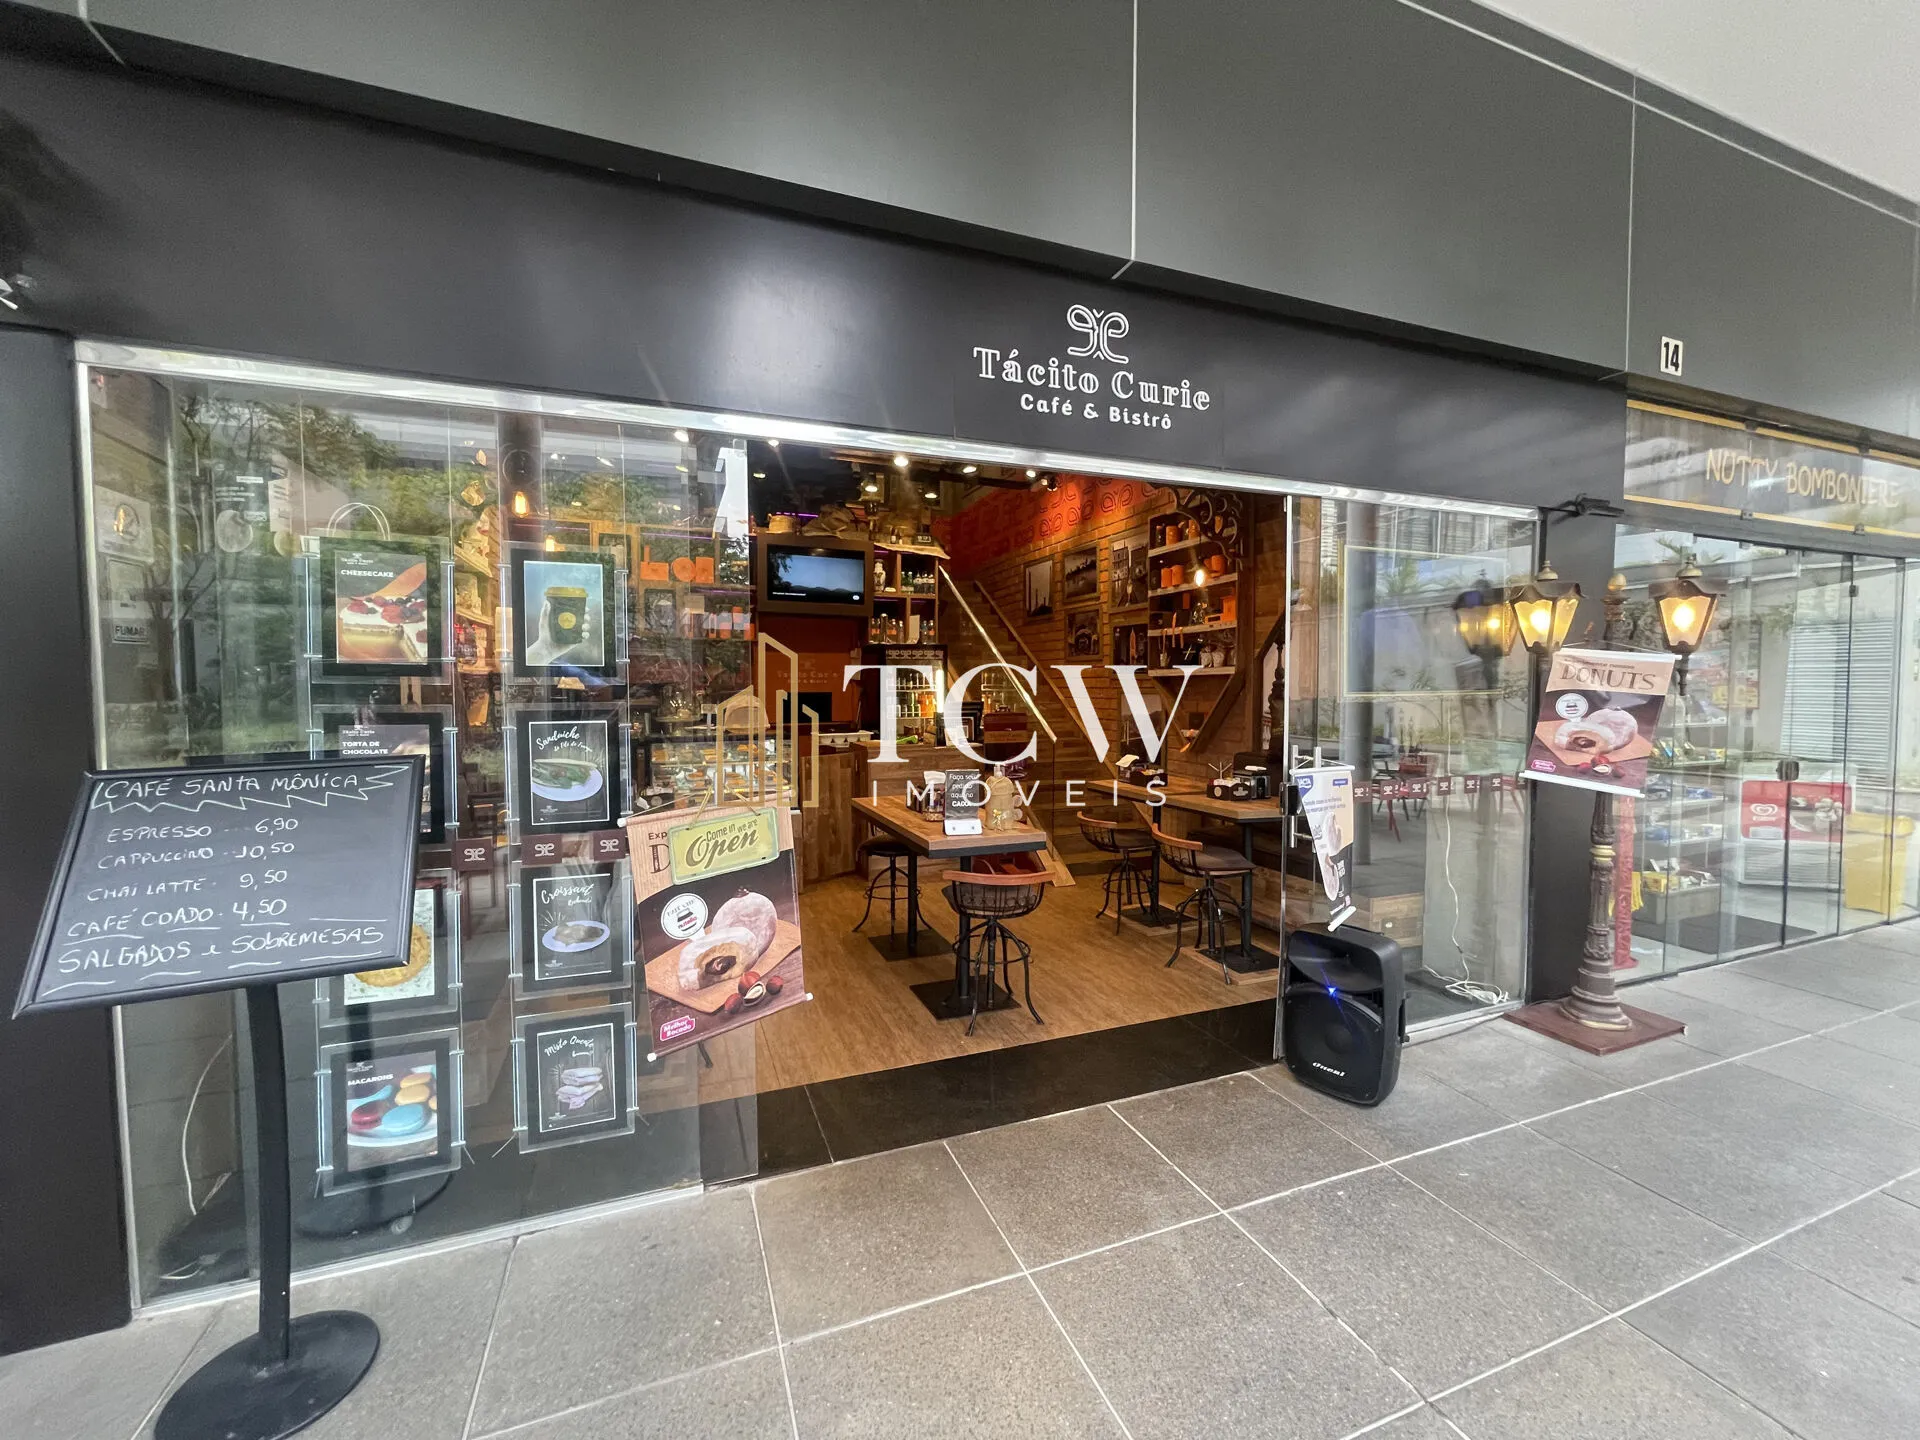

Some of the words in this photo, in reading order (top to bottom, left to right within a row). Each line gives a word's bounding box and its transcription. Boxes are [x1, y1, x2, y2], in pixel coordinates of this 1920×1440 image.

[1664, 341, 1680, 372] 14
[973, 347, 1099, 394] Tácito
[1111, 371, 1210, 410] Curie
[1020, 393, 1072, 415] Café
[1083, 402, 1099, 419] &
[1109, 406, 1172, 430] Bistrô
[1786, 462, 1899, 508] BOMBONIERE
[340, 569, 394, 578] CHEESECAKE
[1560, 663, 1656, 690] DONUTS
[104, 778, 174, 799] CAFÉ
[181, 775, 260, 795] SANTA
[271, 773, 358, 792] MÔNICA
[107, 825, 213, 843] ESPRESSO
[255, 817, 299, 836] 6,90
[706, 827, 729, 842] Come
[729, 823, 736, 833] in
[737, 824, 748, 833] we
[748, 819, 758, 829] are
[97, 847, 214, 869] CAPPUCCINO
[686, 829, 759, 870] Open
[87, 883, 138, 902] CHAI
[239, 870, 288, 891] 9,50
[67, 908, 139, 937] CAFÉ
[141, 907, 214, 927] COADO
[232, 898, 287, 922] 4,50
[58, 941, 191, 973] SALGADOS
[347, 1073, 394, 1086] MACARONS
